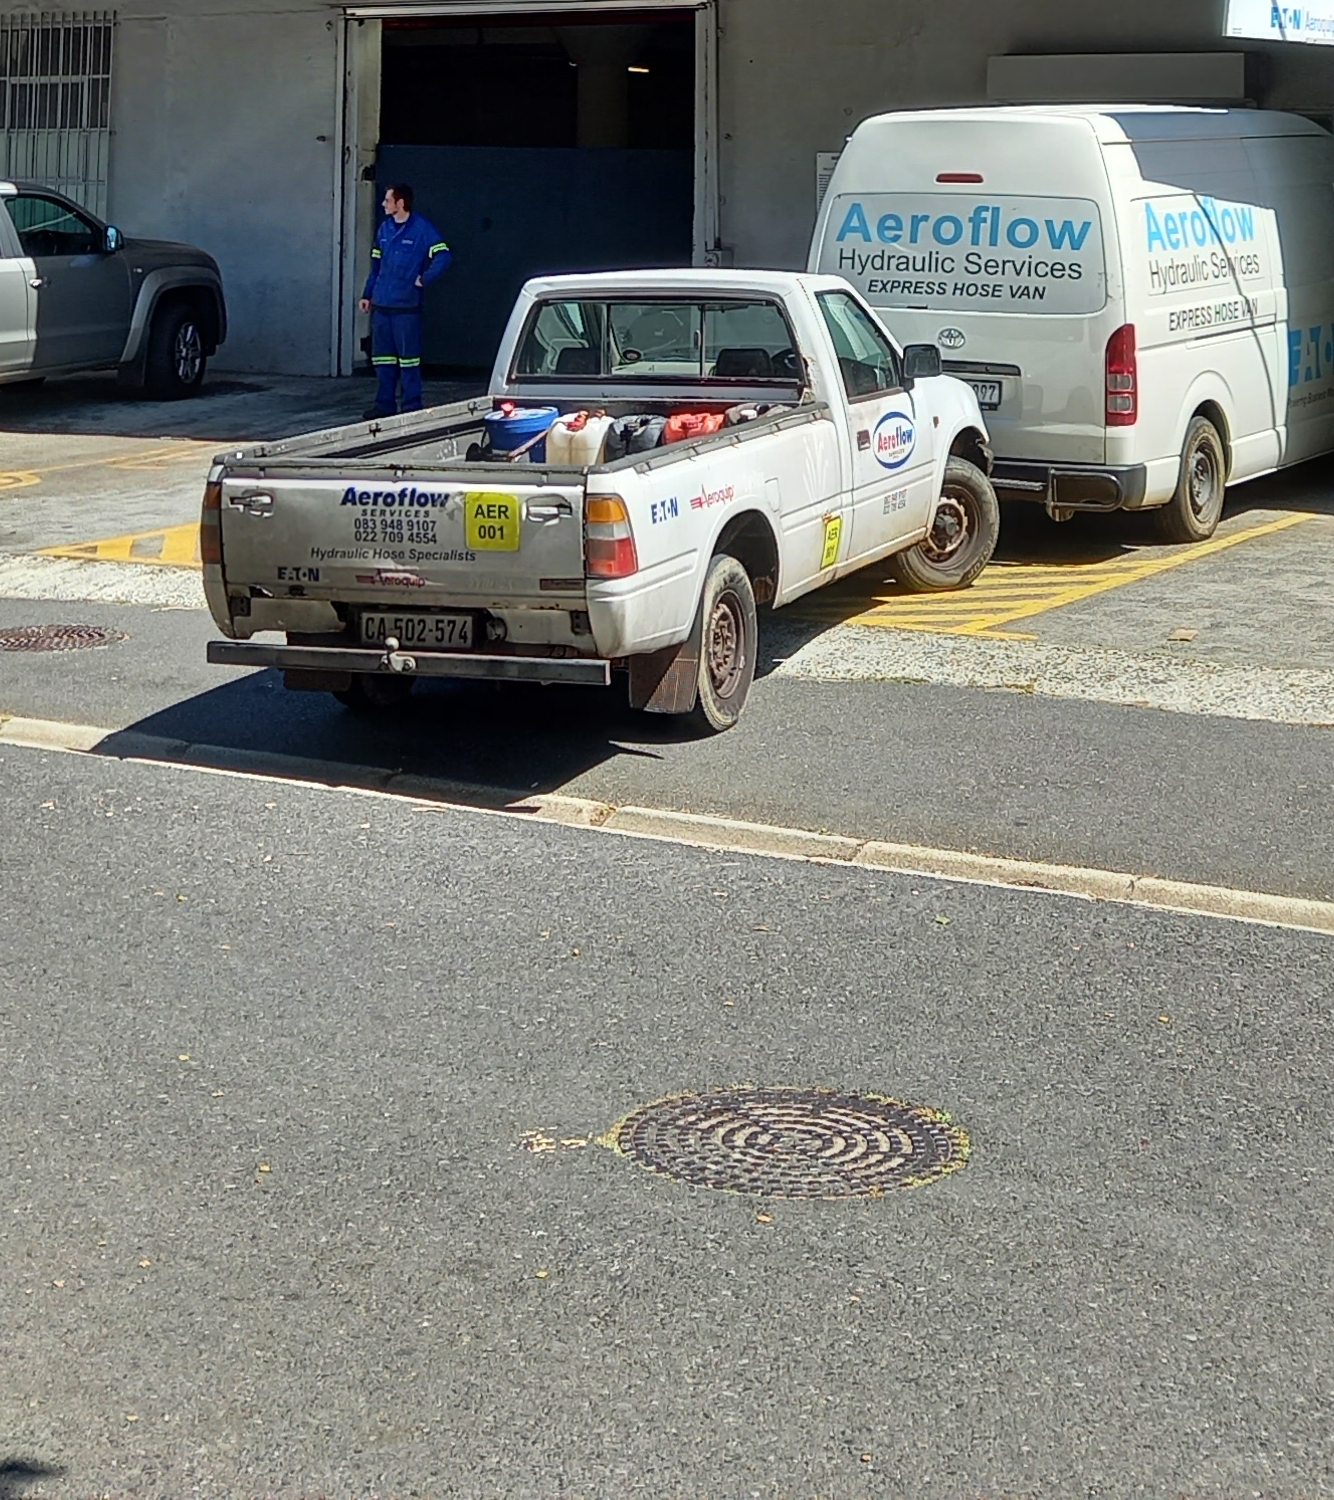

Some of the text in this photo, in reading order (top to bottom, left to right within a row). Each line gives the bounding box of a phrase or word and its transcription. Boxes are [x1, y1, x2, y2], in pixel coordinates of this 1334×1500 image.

[835, 202, 1092, 250] Aeroflow
[1144, 197, 1254, 252] Aeroflow
[838, 248, 1083, 280] Hydraulic Services
[1148, 254, 1209, 294] Hydraulic
[867, 279, 1046, 300] EXPRESS HOSE VAN
[1169, 305, 1213, 332] EXPRESS
[1214, 301, 1239, 323] HOSE
[877, 425, 913, 453] Aeroflow
[340, 487, 450, 507] Aeroflow
[700, 483, 734, 509] Aeroquip
[361, 508, 430, 518] SERVICES
[474, 504, 509, 520] AER
[354, 518, 437, 533] 083 948 9107
[478, 525, 505, 540] 001
[354, 531, 437, 544] 022 709 4554
[310, 547, 477, 562] Hydraulic Hose Specialists
[373, 568, 426, 588] Aeroquip
